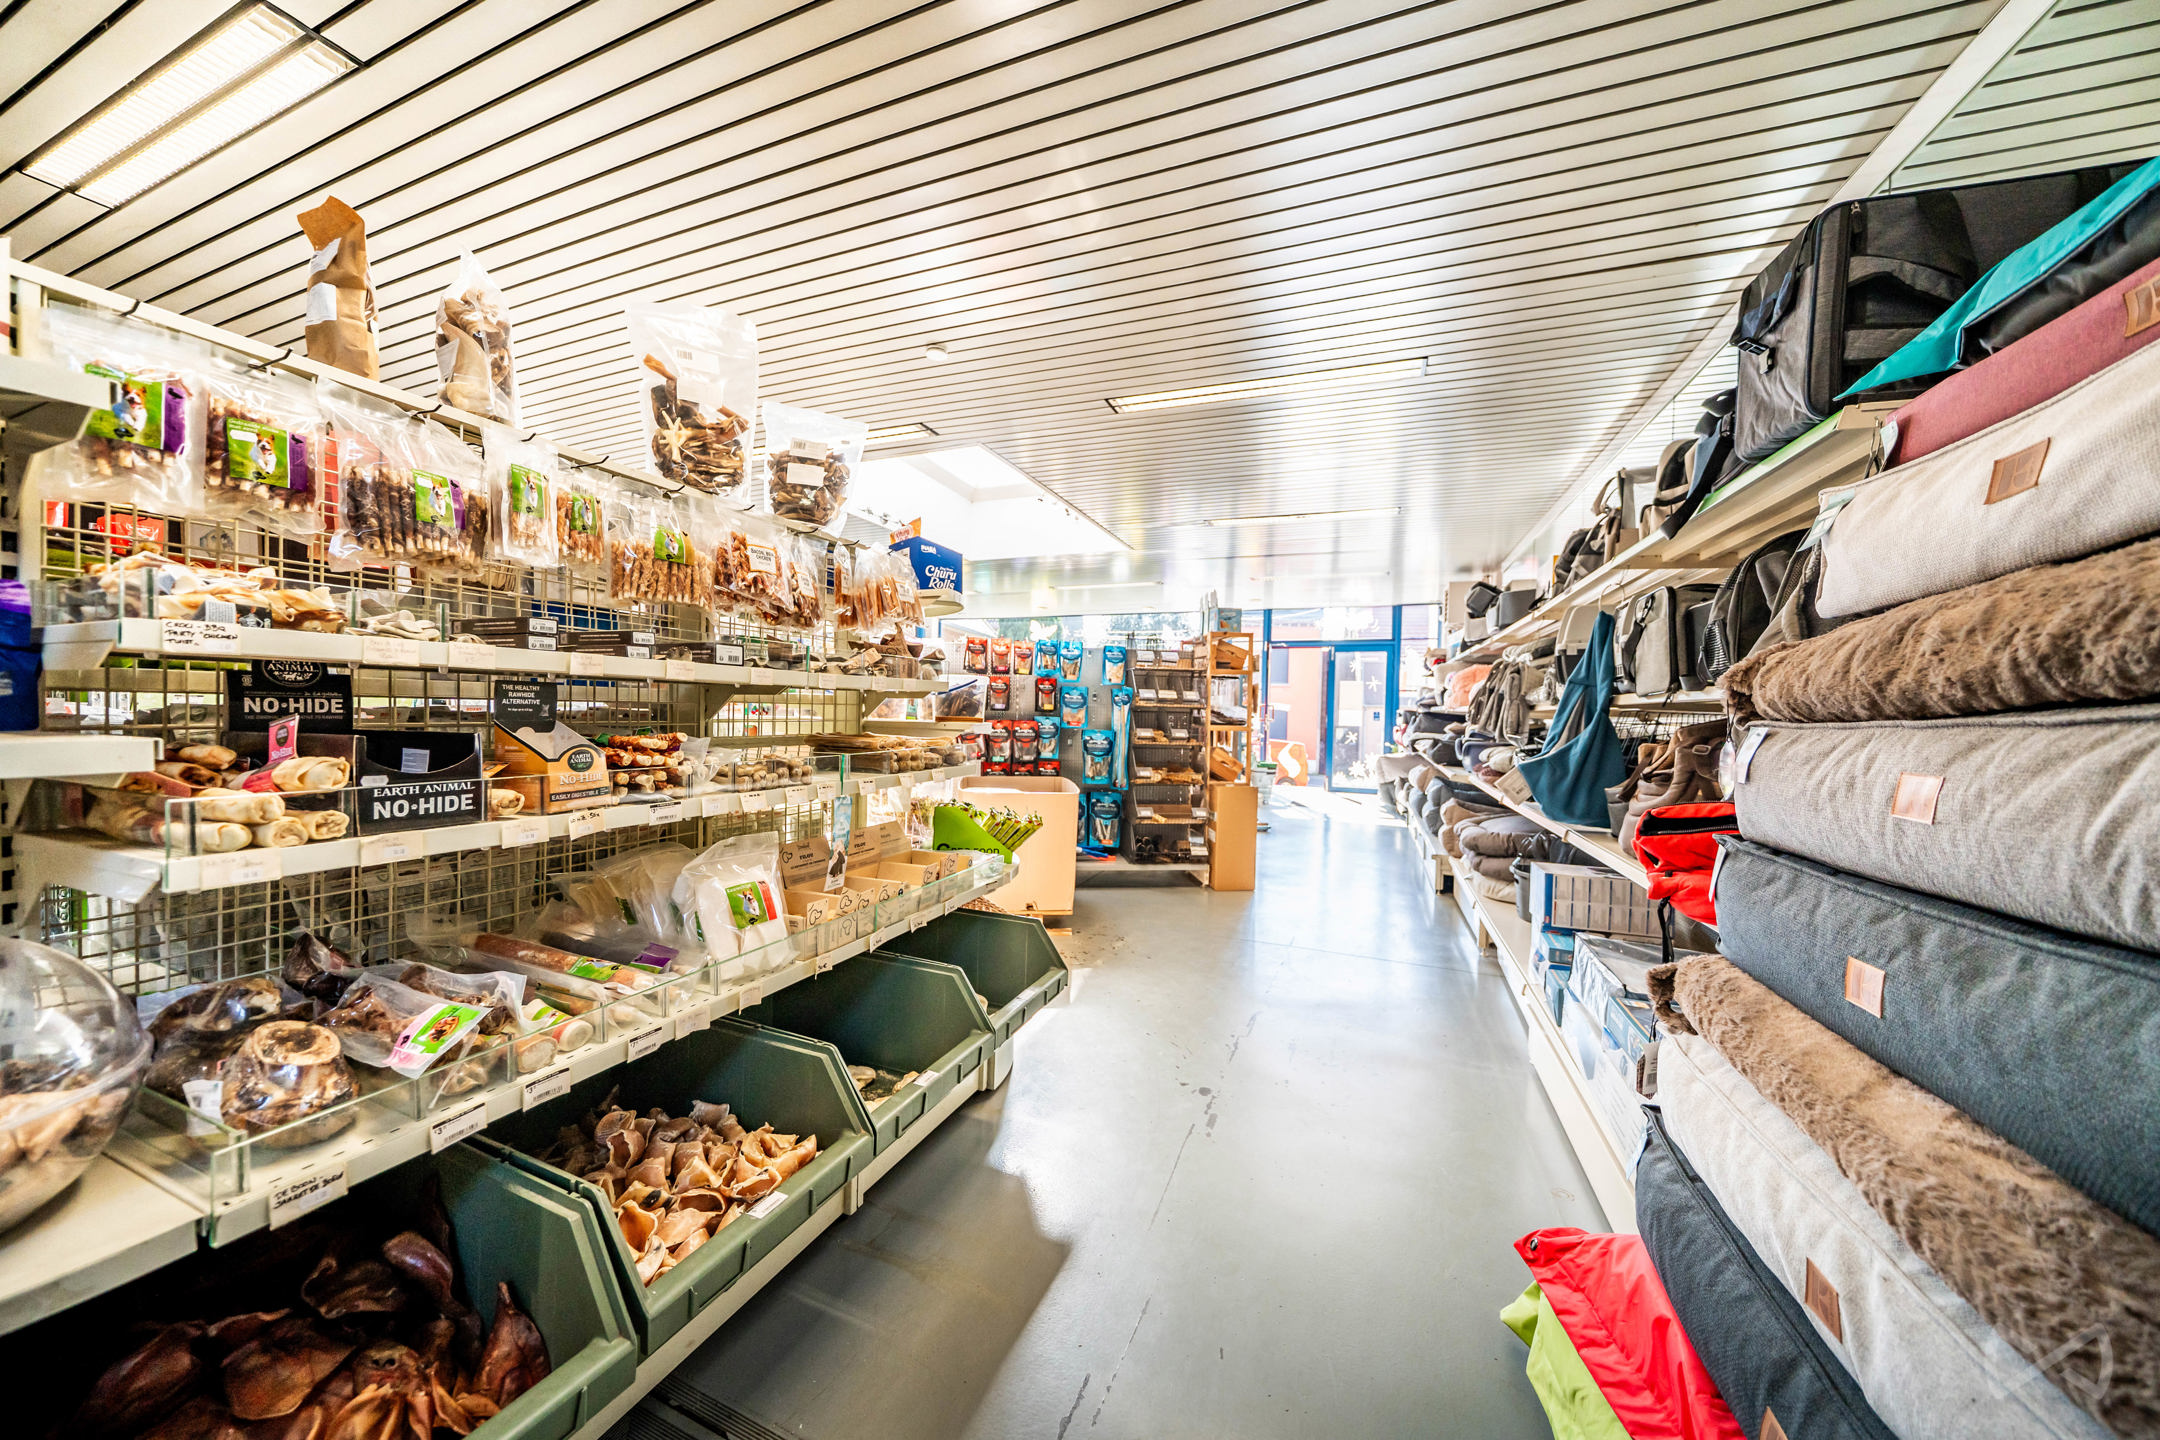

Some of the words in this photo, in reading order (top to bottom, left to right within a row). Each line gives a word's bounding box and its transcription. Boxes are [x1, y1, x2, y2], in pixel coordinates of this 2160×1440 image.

[925, 564, 957, 580] Churu
[928, 577, 955, 589] Rolls
[267, 663, 314, 672] ANIMAL
[514, 684, 541, 692] HEALTHY
[373, 786, 420, 797] EARTH
[423, 782, 476, 794] ANIMAL
[551, 793, 572, 801] EASILY
[571, 790, 599, 799] DIGESTIBLE
